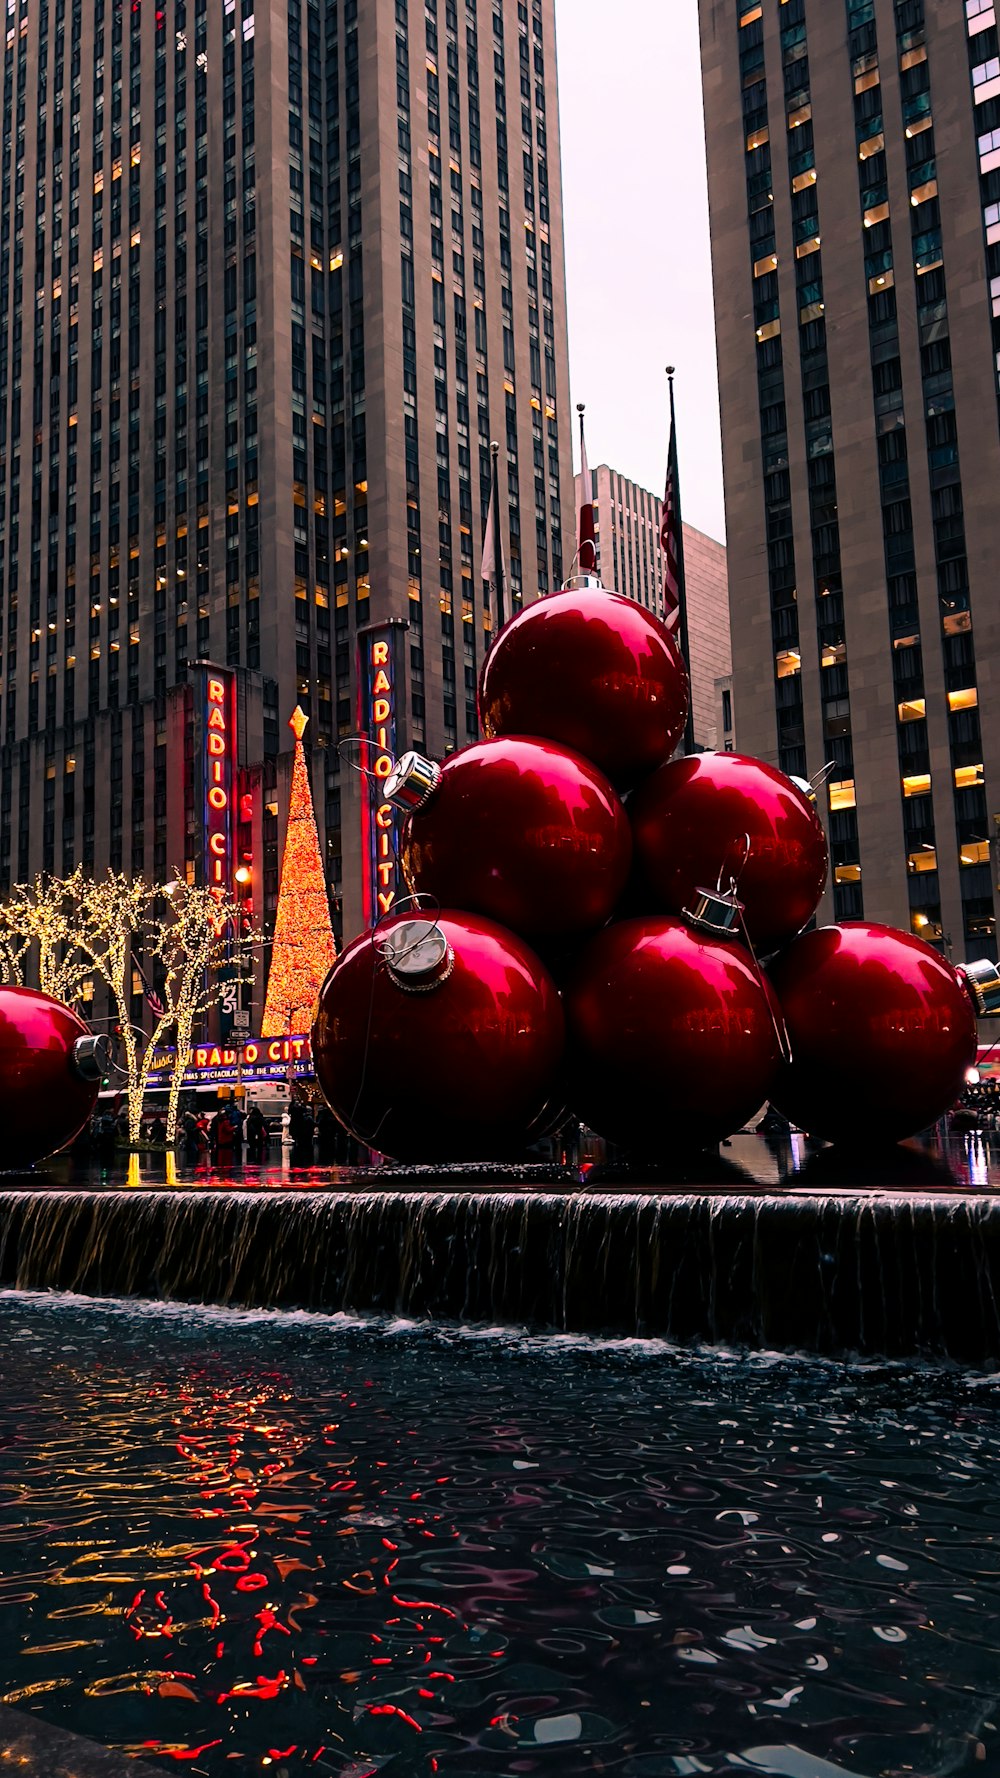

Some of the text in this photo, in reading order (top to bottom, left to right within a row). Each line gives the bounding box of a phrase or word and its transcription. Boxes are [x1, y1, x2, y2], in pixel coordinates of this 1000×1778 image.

[208, 679, 226, 809] RADIO
[372, 641, 395, 914] RADIO CITY
[195, 1043, 259, 1067] RADO
